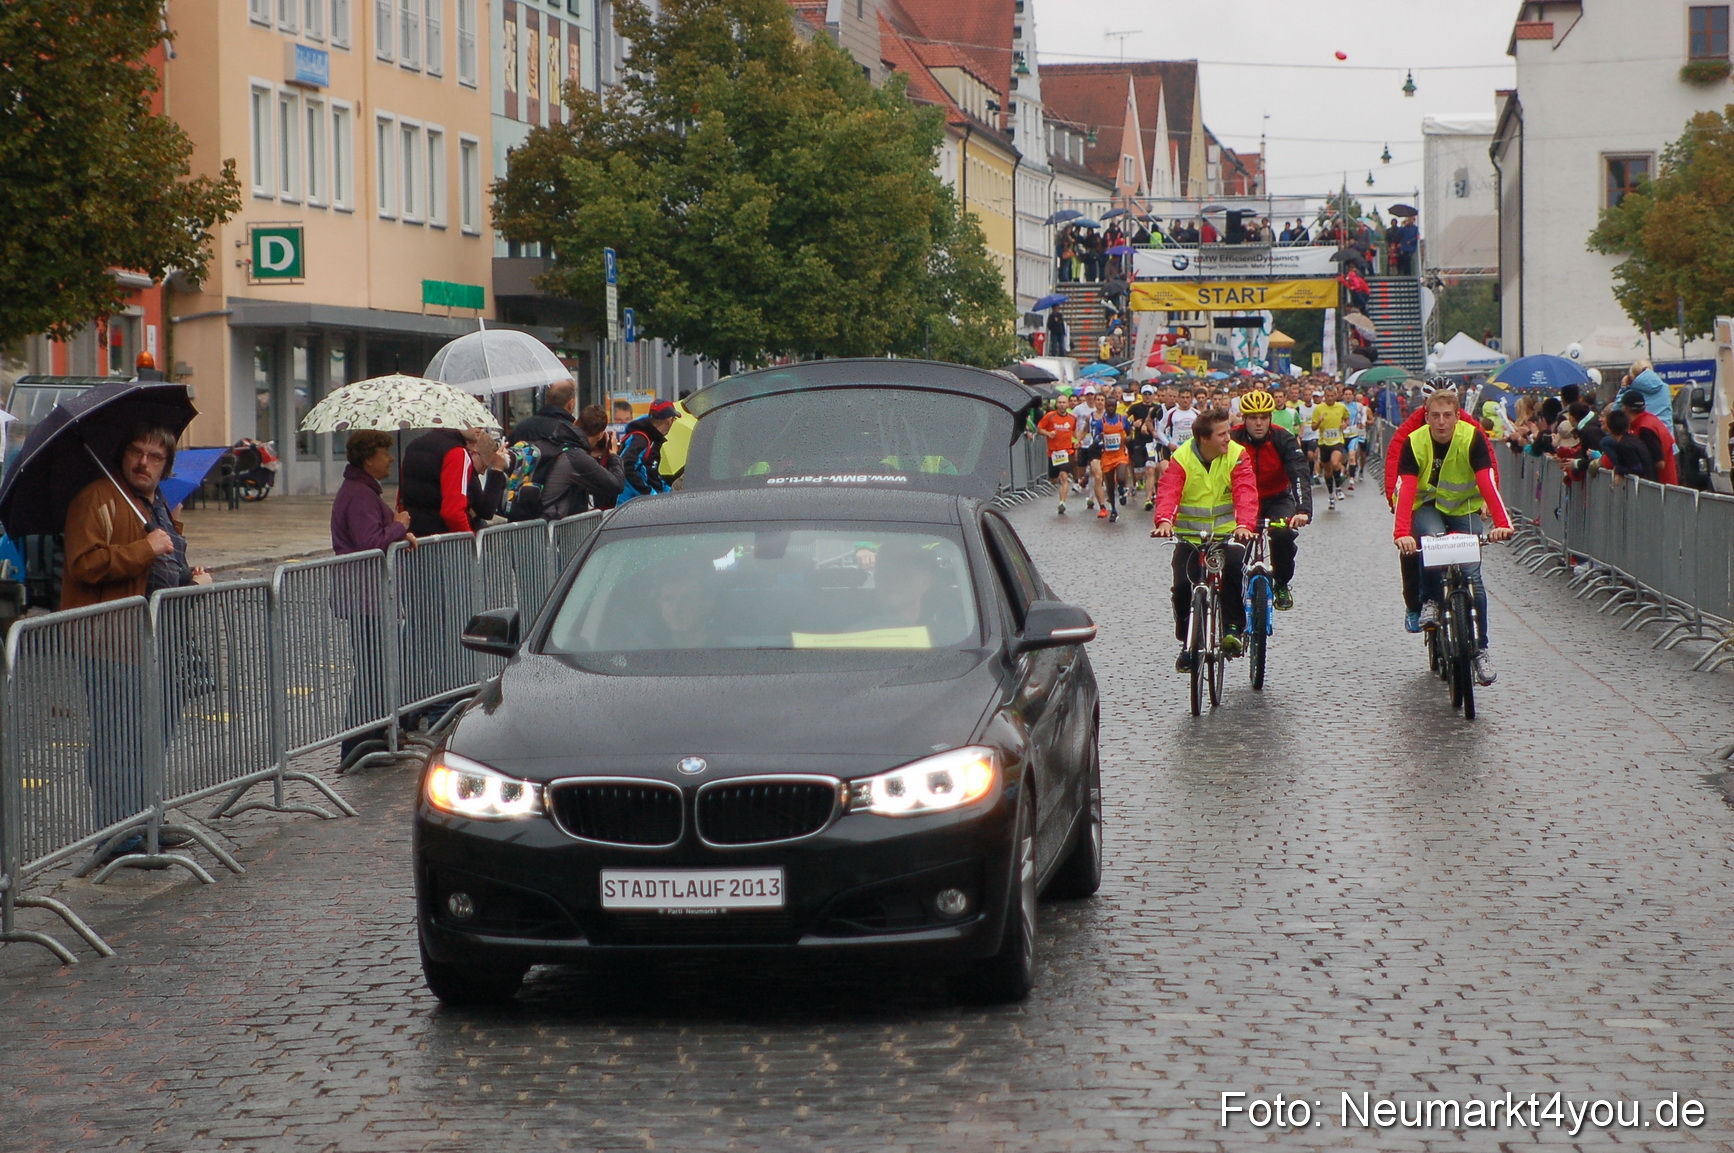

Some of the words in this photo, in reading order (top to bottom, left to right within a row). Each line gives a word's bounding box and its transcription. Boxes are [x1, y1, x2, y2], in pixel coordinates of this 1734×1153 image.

[260, 235, 295, 271] D
[1219, 253, 1300, 263] EfficientDyamics
[607, 252, 614, 279] P
[1197, 287, 1268, 305] START
[626, 312, 632, 339] P
[1197, 365, 1205, 374] A
[1667, 370, 1688, 379] Bilder
[1689, 369, 1710, 377] unter:
[1423, 541, 1478, 551] Halbmarathon
[604, 878, 781, 898] STADTLAUF2013
